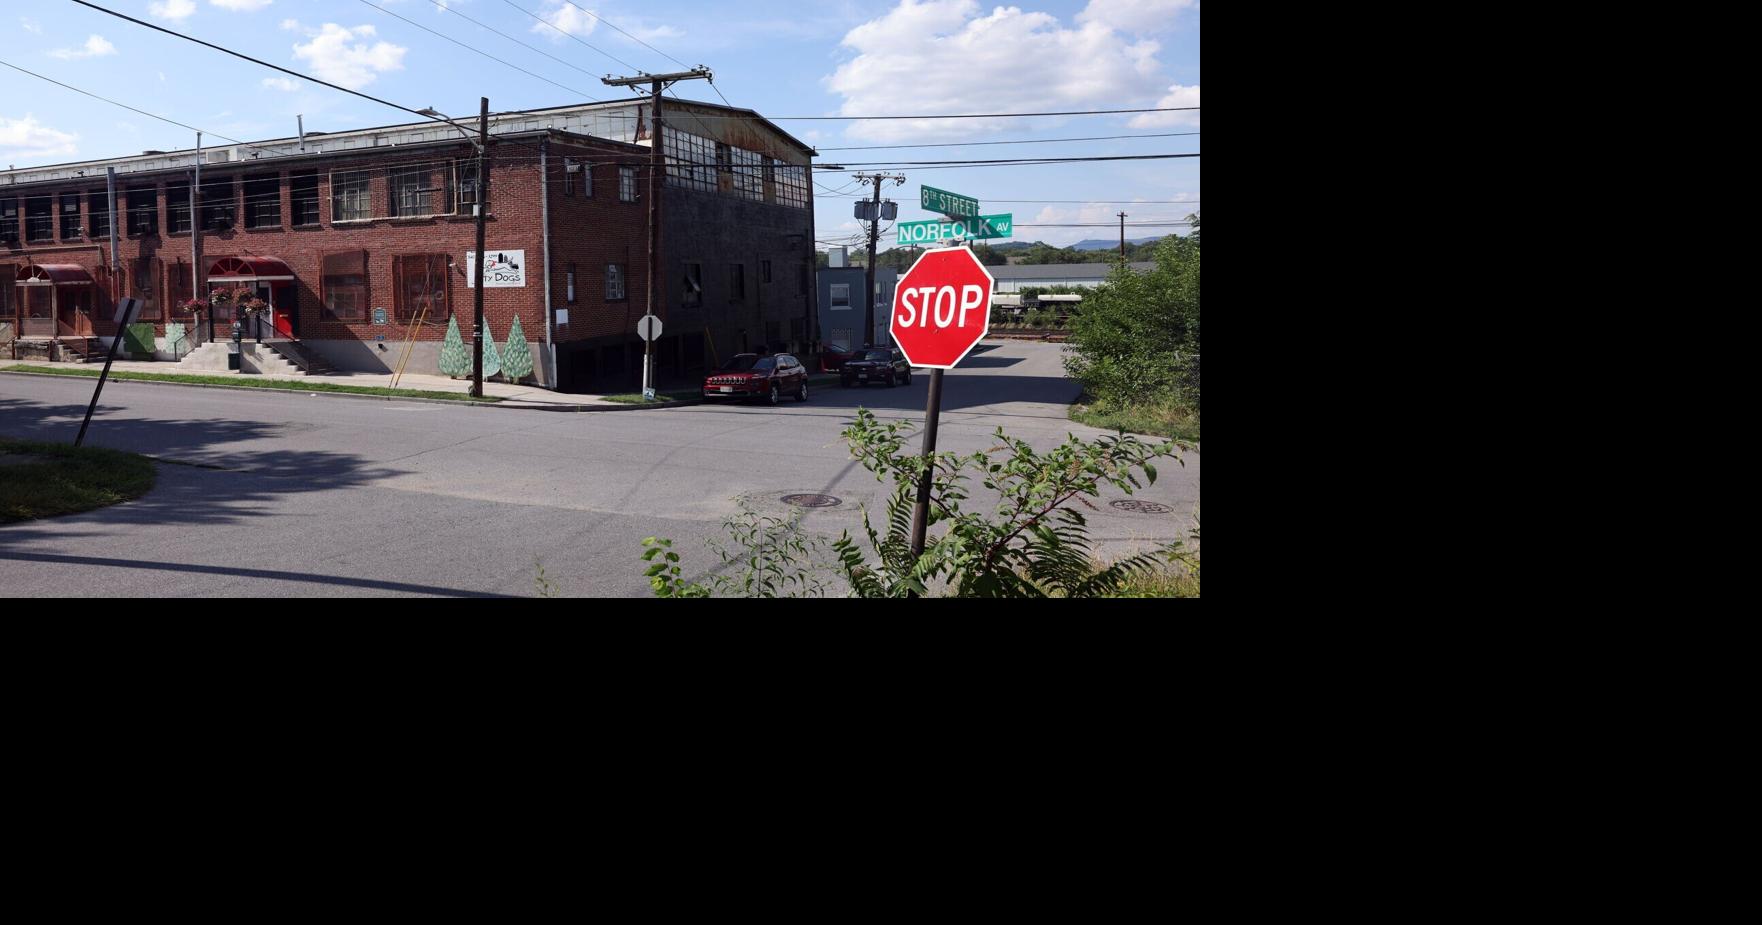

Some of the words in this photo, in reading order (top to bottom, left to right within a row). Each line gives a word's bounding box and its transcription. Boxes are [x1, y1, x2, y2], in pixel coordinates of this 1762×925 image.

[922, 189, 937, 206] 8TH
[939, 193, 977, 217] STREET
[899, 218, 992, 241] NORFOLK
[996, 222, 1009, 232] AV
[495, 272, 521, 282] DOGS
[898, 284, 983, 328] STOP
